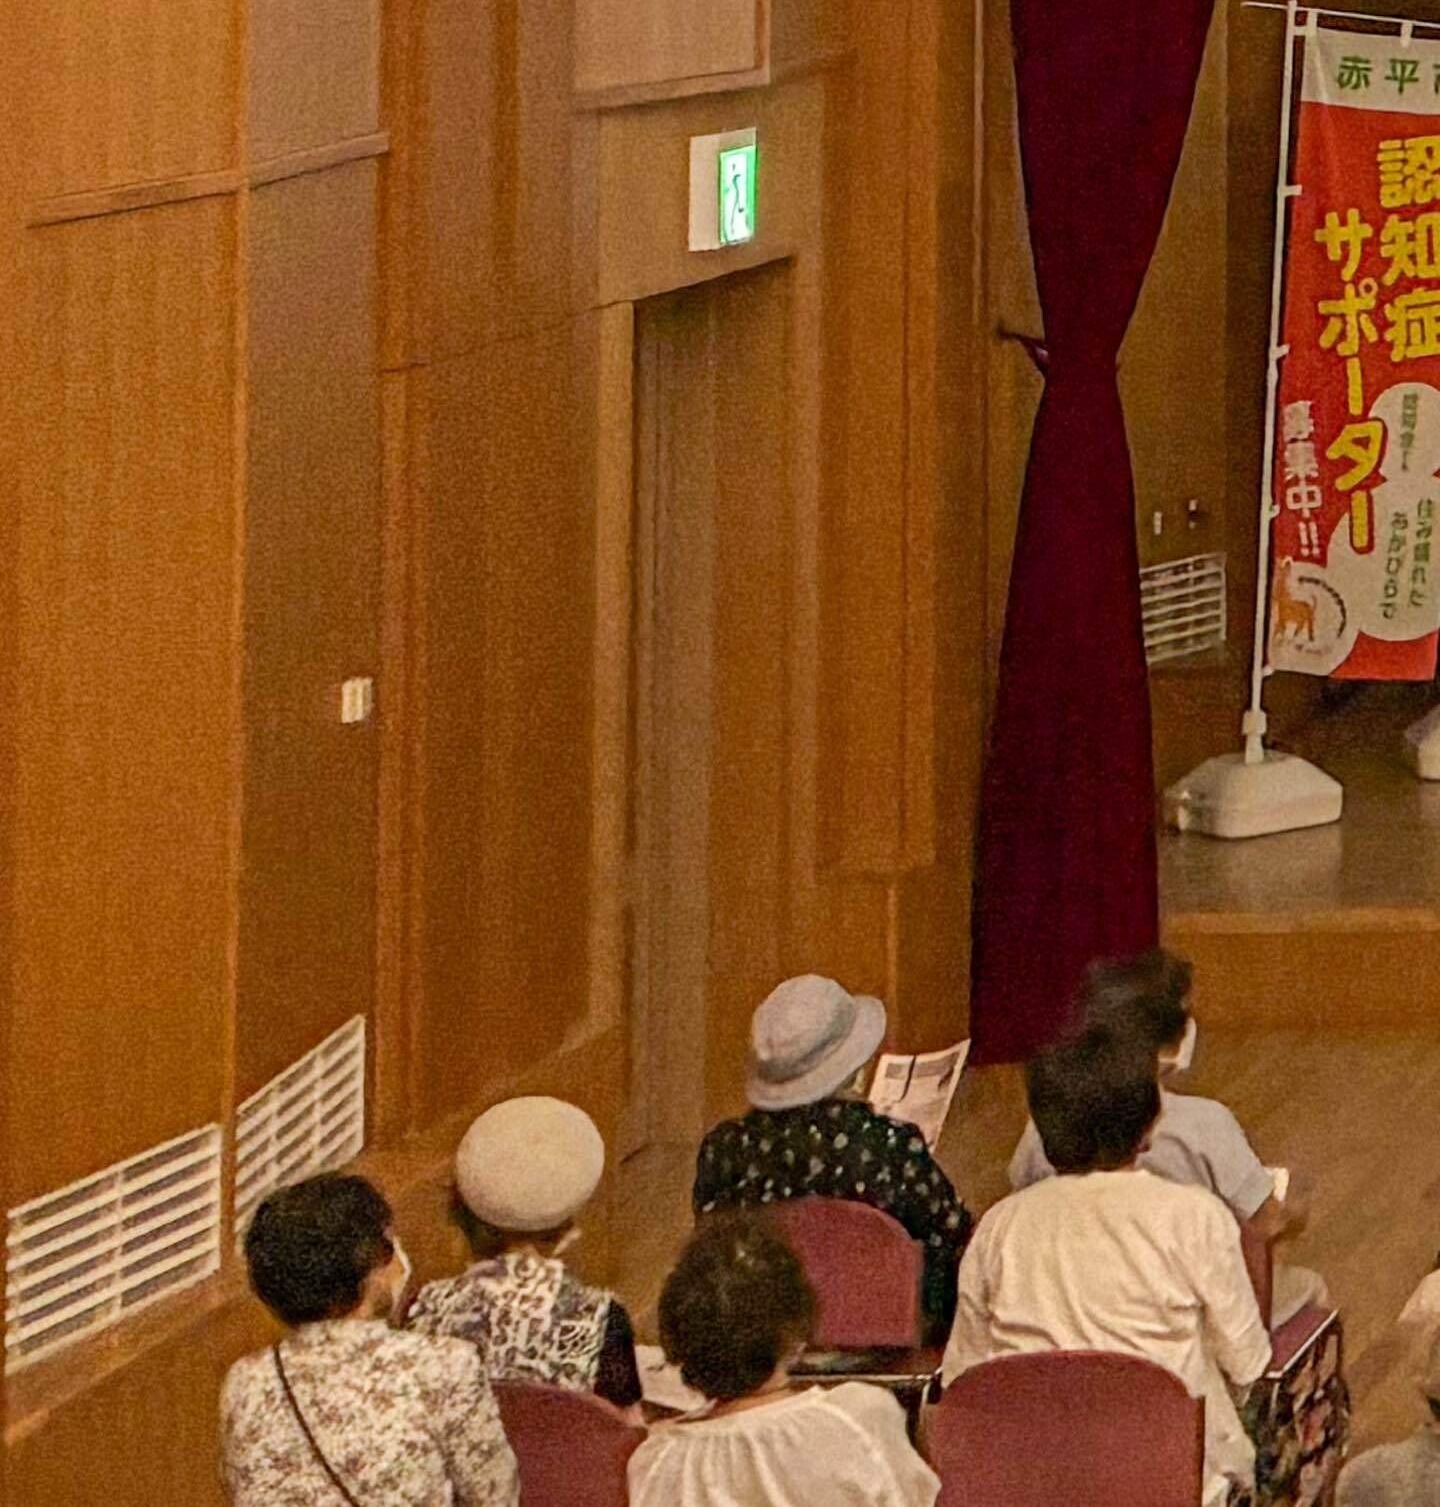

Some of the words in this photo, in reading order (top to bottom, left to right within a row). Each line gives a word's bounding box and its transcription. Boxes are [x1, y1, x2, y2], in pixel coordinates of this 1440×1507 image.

[1313, 207, 1386, 554] サポーター
